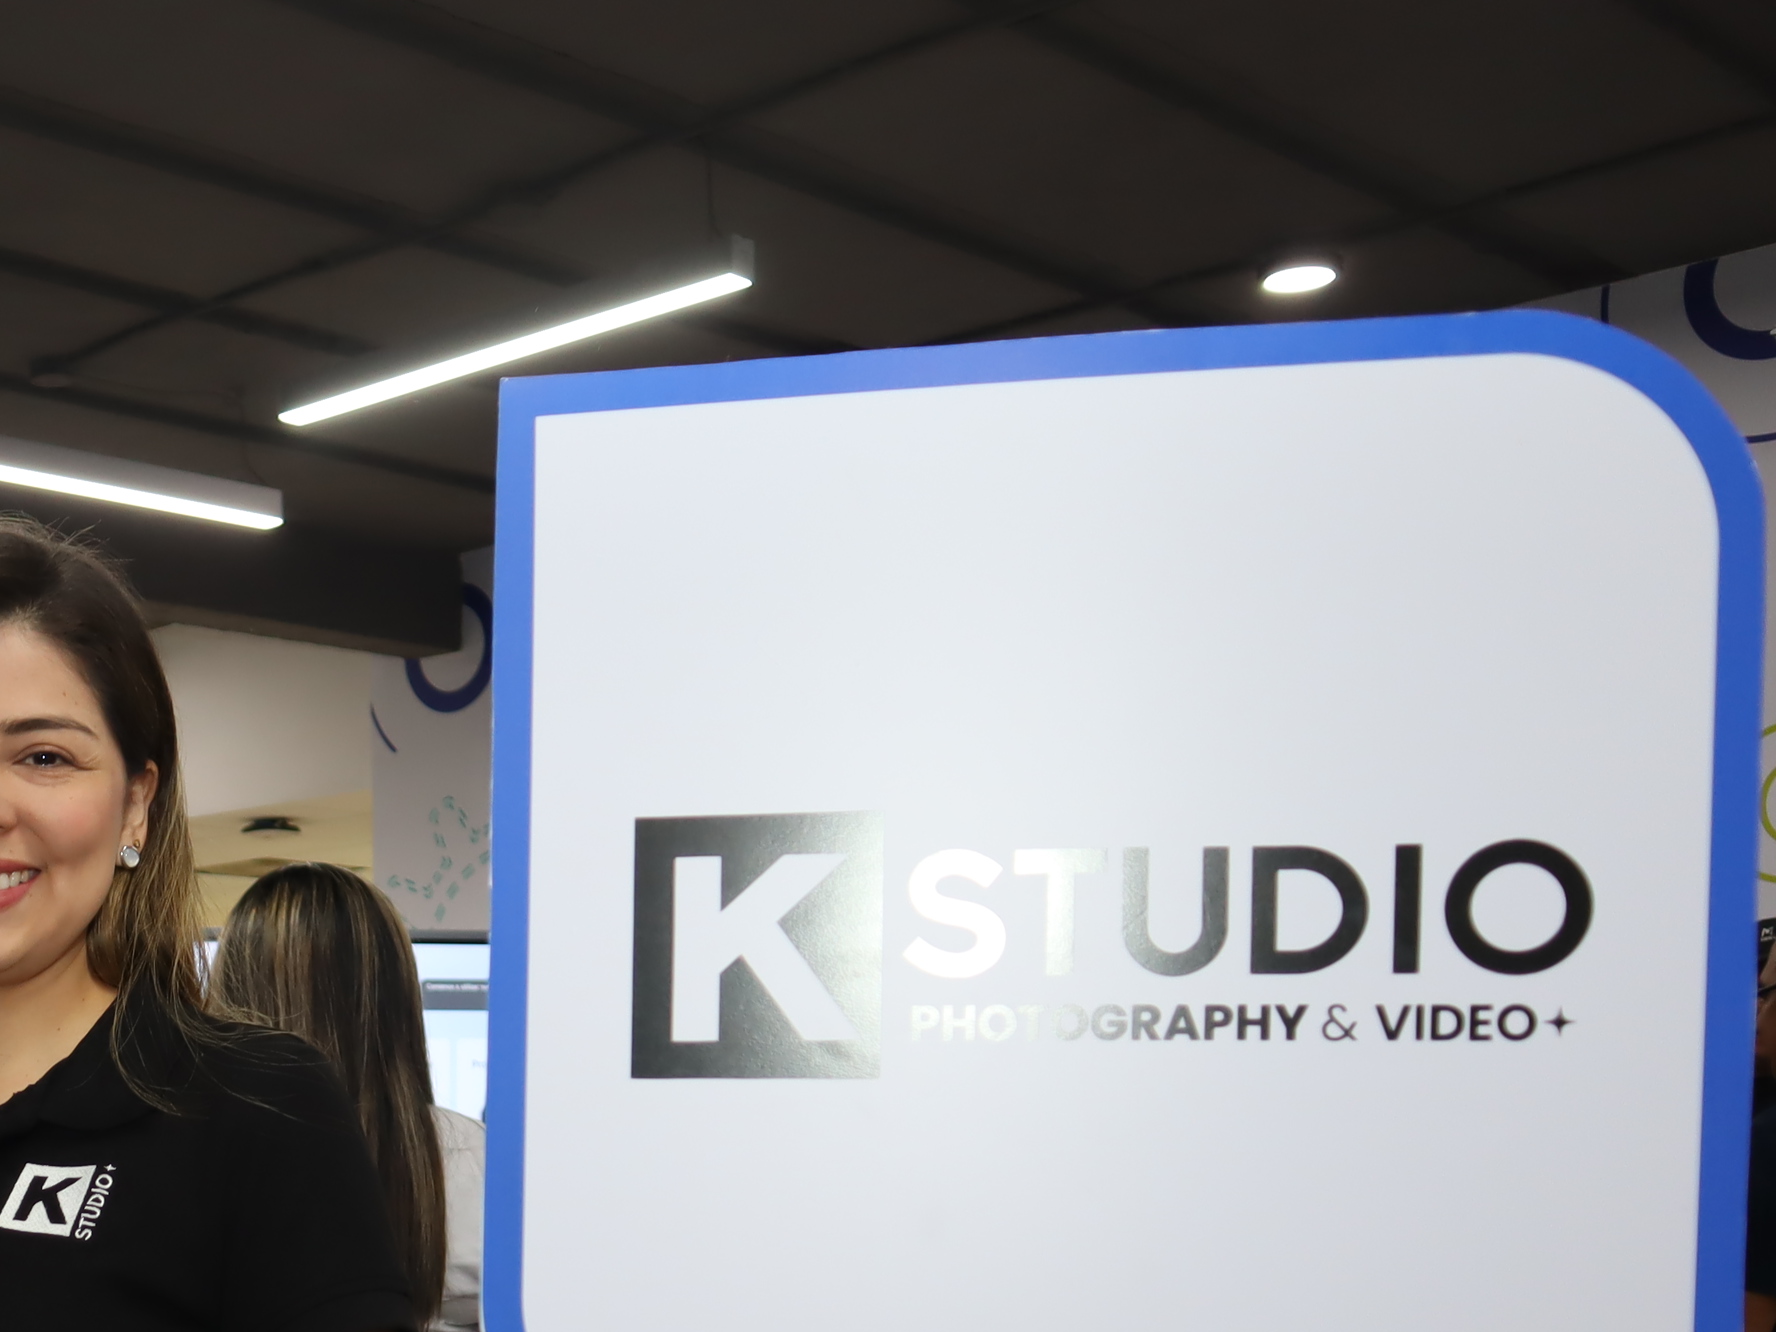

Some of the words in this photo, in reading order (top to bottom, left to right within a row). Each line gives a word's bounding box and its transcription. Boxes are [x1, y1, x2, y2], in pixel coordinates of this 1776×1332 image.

[670, 853, 861, 1042] K
[902, 838, 1594, 979] STUDIO
[911, 1002, 1309, 1042] PHOTOGRAPHY
[1322, 1002, 1359, 1042] &
[1375, 1002, 1538, 1042] VIDEO
[74, 1173, 114, 1241] STUDIO
